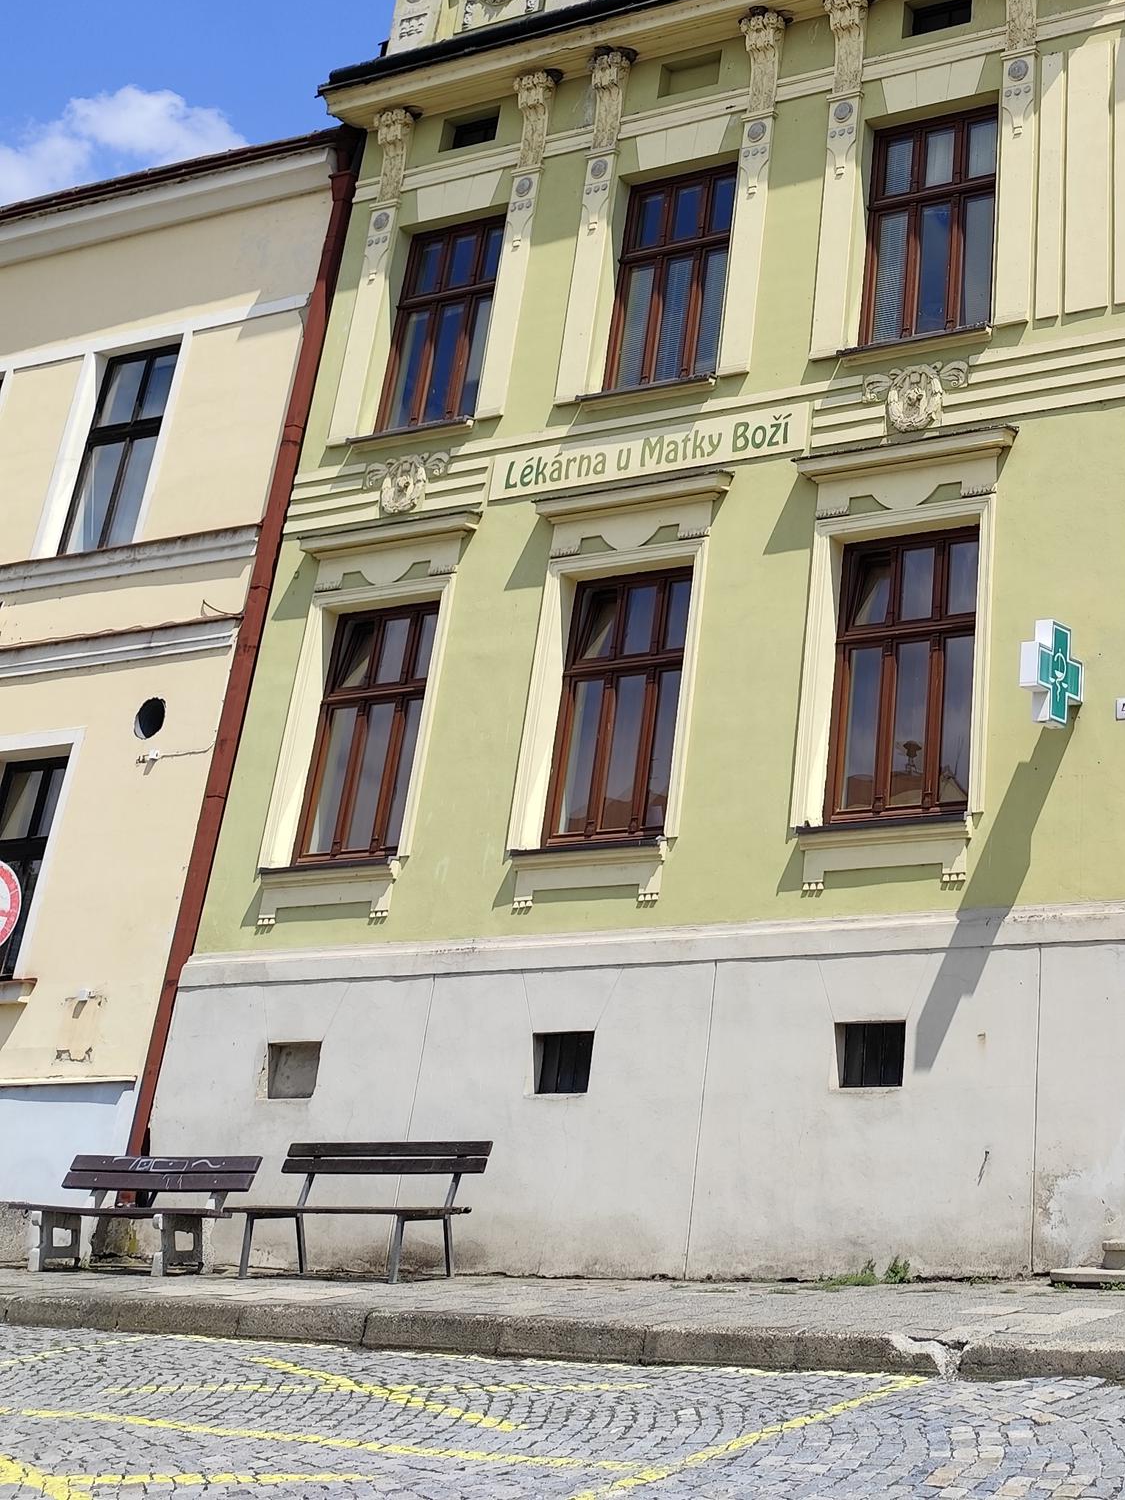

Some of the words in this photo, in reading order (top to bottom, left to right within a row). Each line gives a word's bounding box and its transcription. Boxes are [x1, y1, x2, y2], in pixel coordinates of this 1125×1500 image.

[504, 451, 607, 490] Lékárna
[616, 447, 632, 472] u
[639, 429, 723, 468] Matky
[731, 412, 793, 453] Boží
